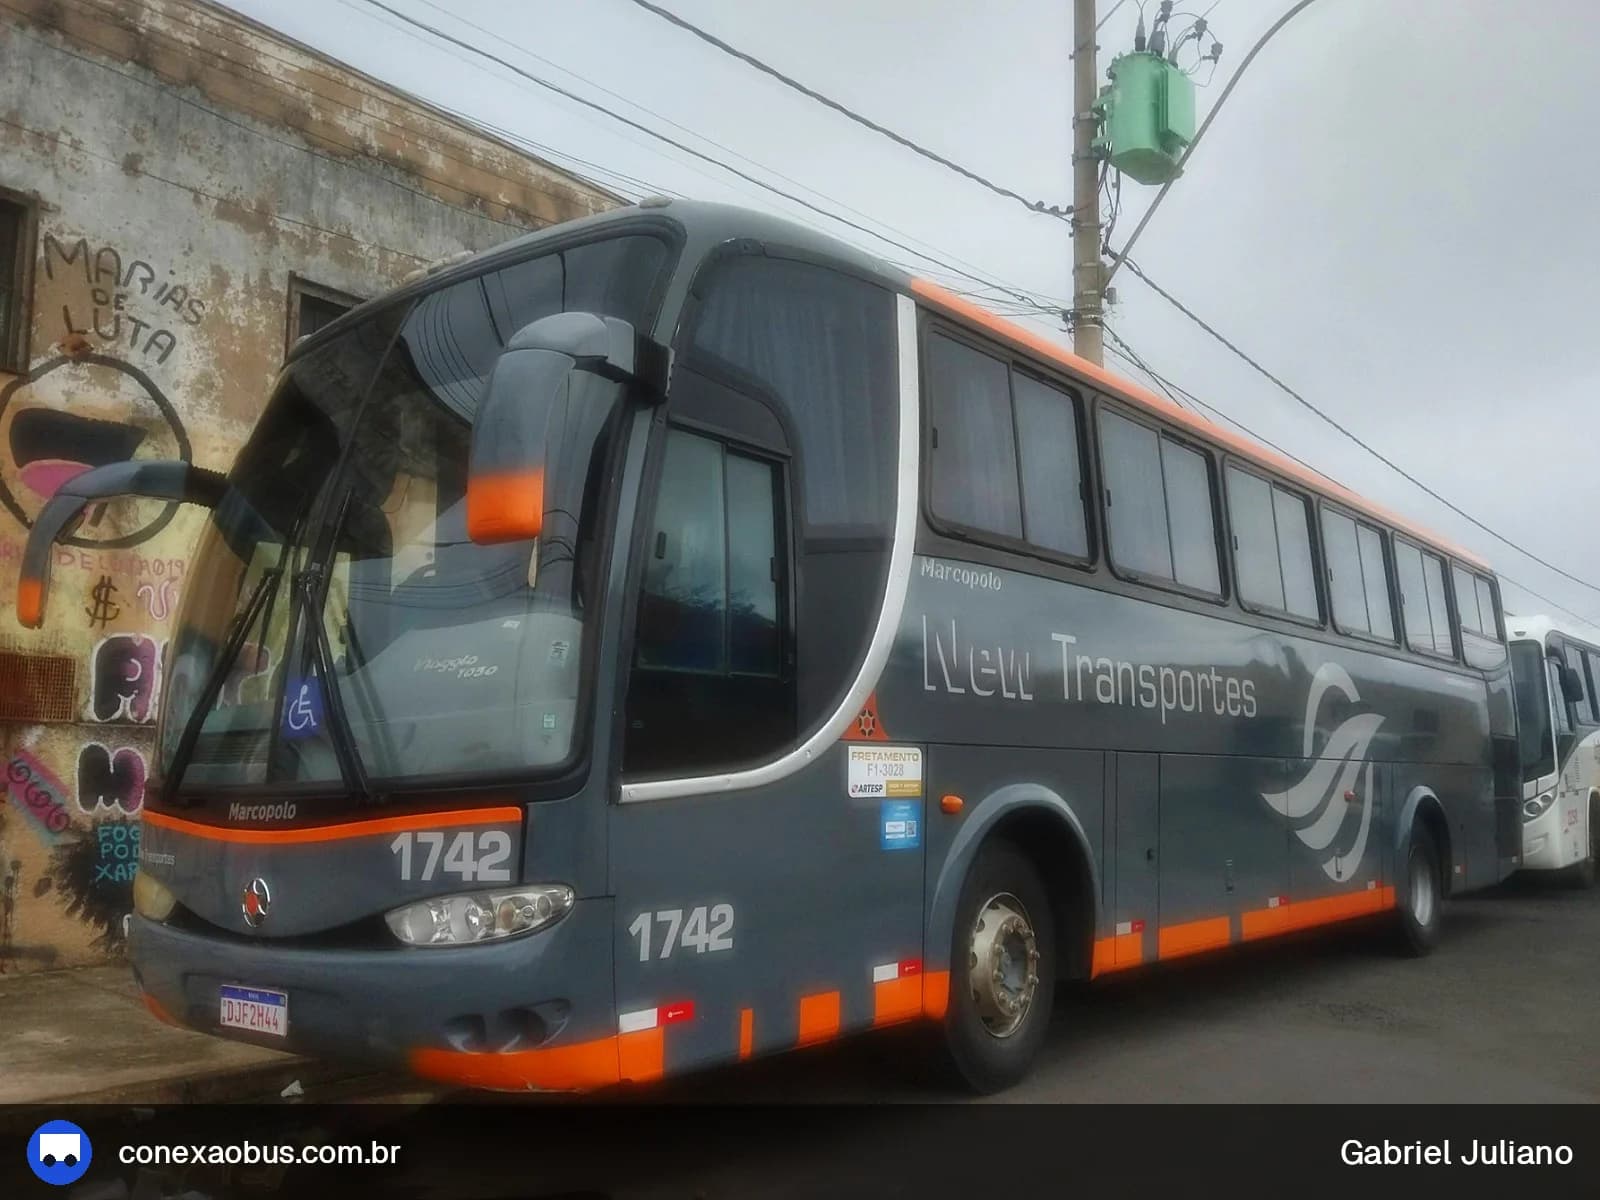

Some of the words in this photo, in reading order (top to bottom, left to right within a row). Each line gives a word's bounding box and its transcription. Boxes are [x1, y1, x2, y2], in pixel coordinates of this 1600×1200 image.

[44, 231, 206, 326] MARIAS
[92, 288, 128, 311] DE
[62, 304, 177, 365] LUTA
[920, 556, 1002, 592] Marcopolo
[922, 614, 1034, 701] New
[1051, 632, 1257, 725] Transportes
[851, 751, 920, 762] FRETAMENTO
[858, 783, 883, 793] ARTESP
[228, 800, 297, 821] Marcopolo
[390, 830, 512, 882] 1742
[628, 903, 735, 962] 1742
[227, 1000, 279, 1031] DJF2H44
